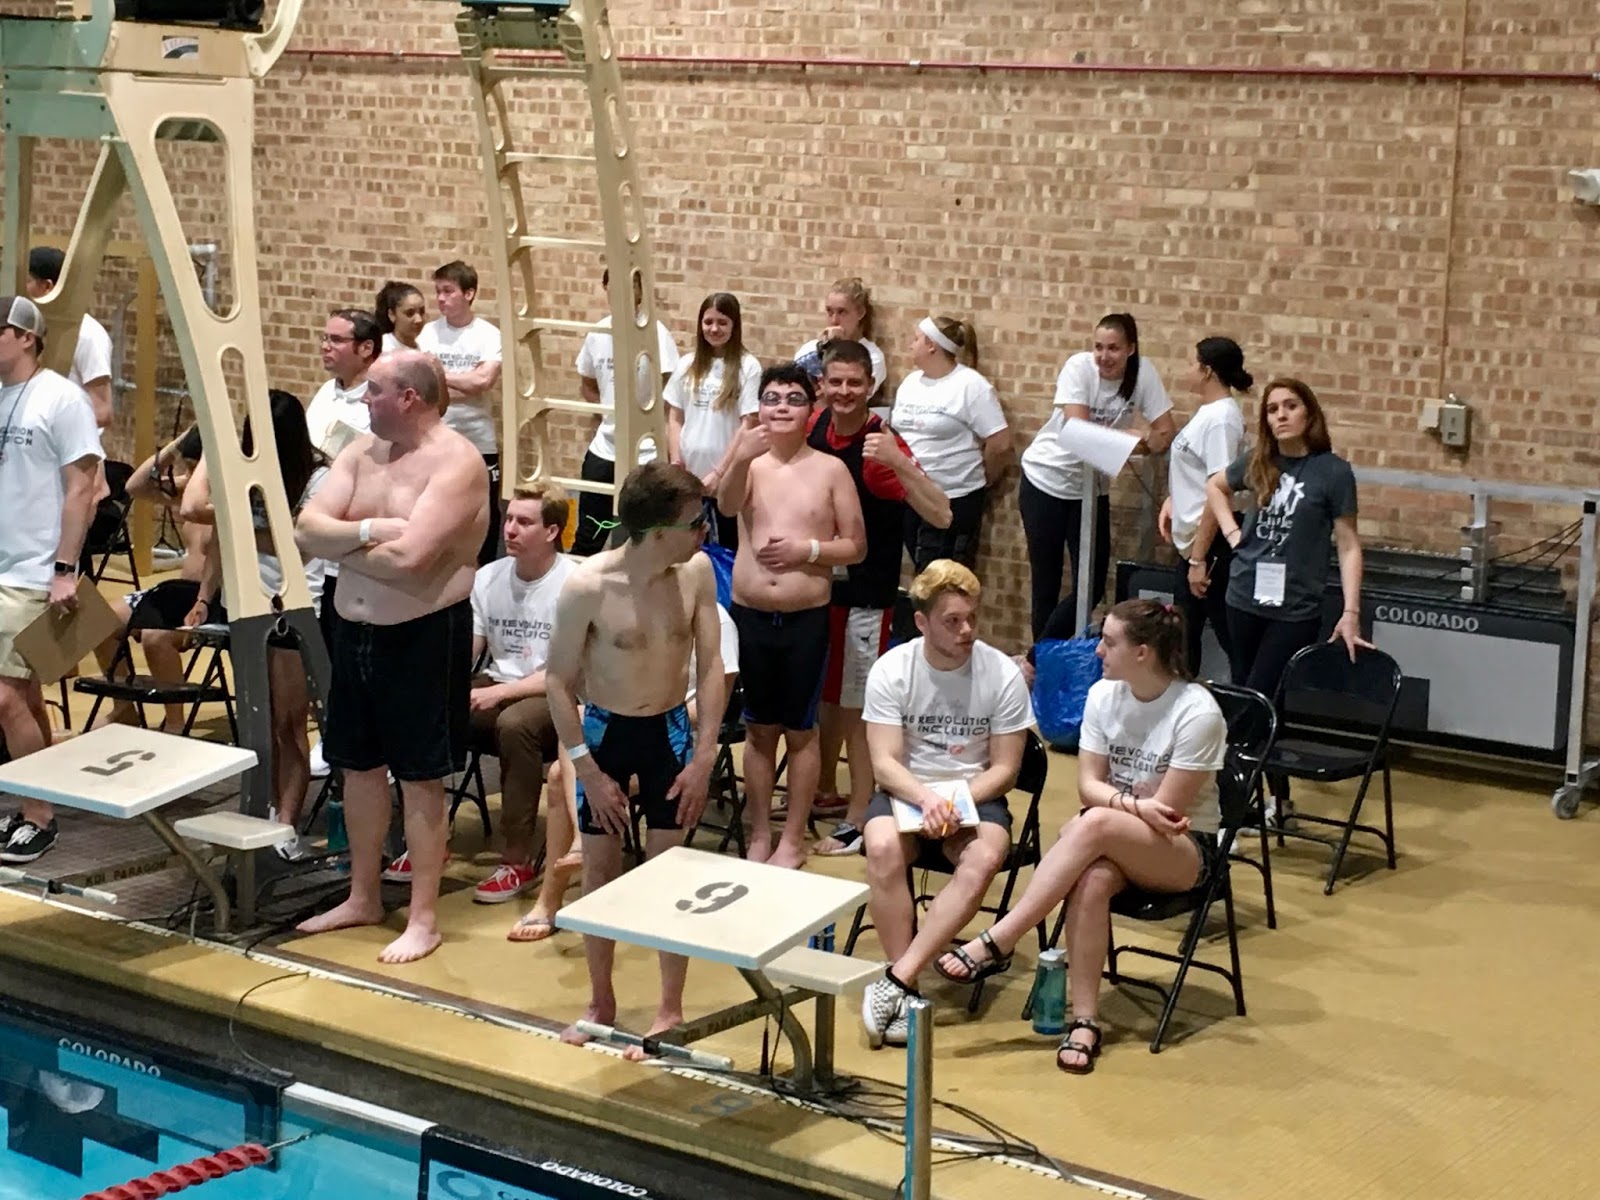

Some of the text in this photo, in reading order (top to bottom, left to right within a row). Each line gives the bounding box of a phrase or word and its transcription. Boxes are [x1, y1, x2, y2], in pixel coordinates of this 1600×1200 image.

[1374, 604, 1479, 632] COLORADO
[917, 725, 992, 736] INCLUSIO
[918, 714, 992, 726] REVOLUTIO
[80, 749, 156, 776] 5
[541, 1160, 648, 1198] COLORADO
